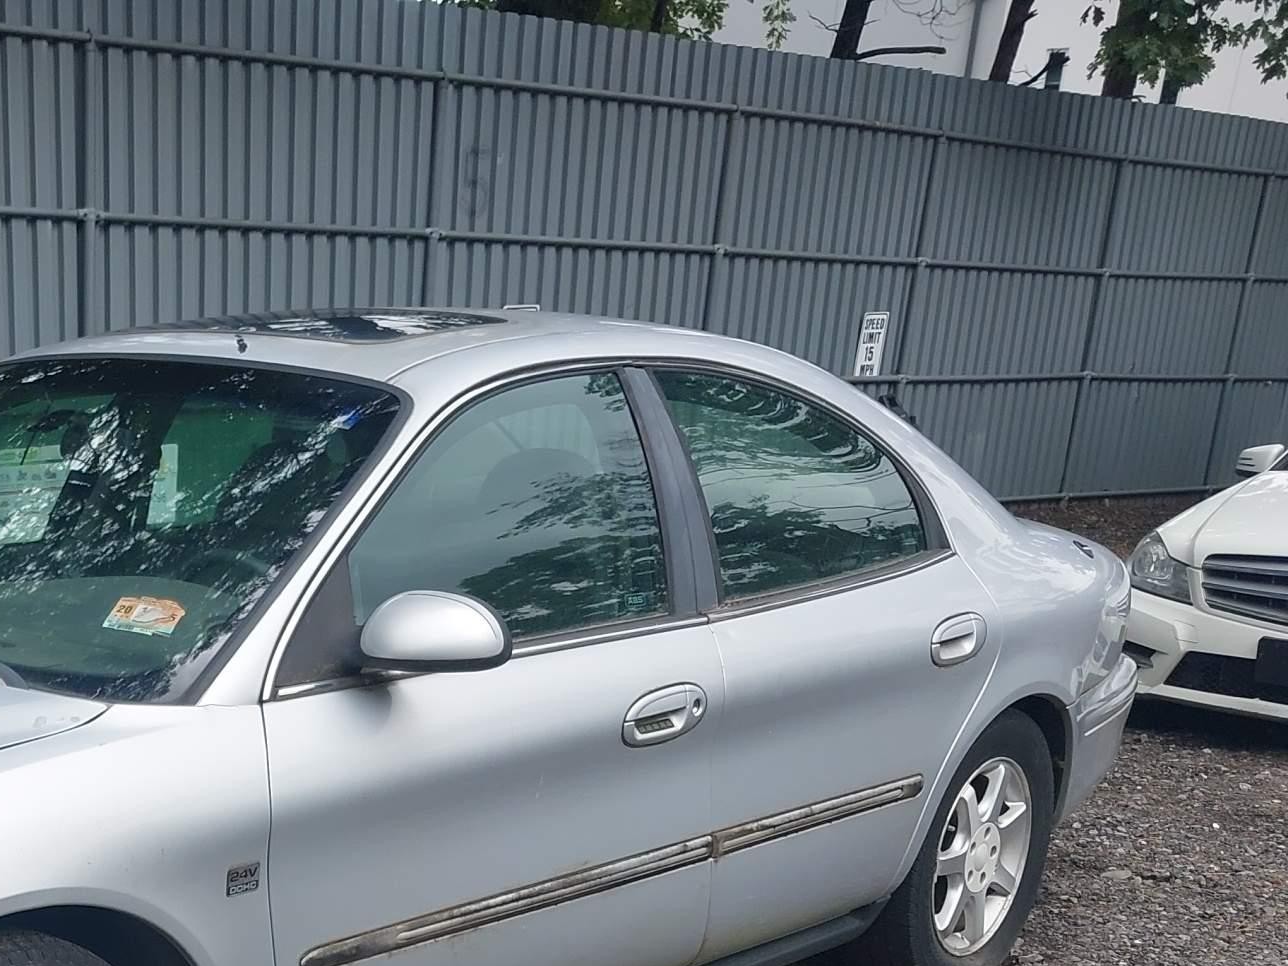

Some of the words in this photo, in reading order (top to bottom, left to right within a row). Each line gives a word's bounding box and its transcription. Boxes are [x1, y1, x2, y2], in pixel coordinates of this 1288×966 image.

[864, 318, 885, 330] SPEED
[862, 331, 882, 345] LIMIT
[864, 345, 875, 362] 15
[859, 364, 874, 376] MPH
[230, 866, 258, 882] 24V
